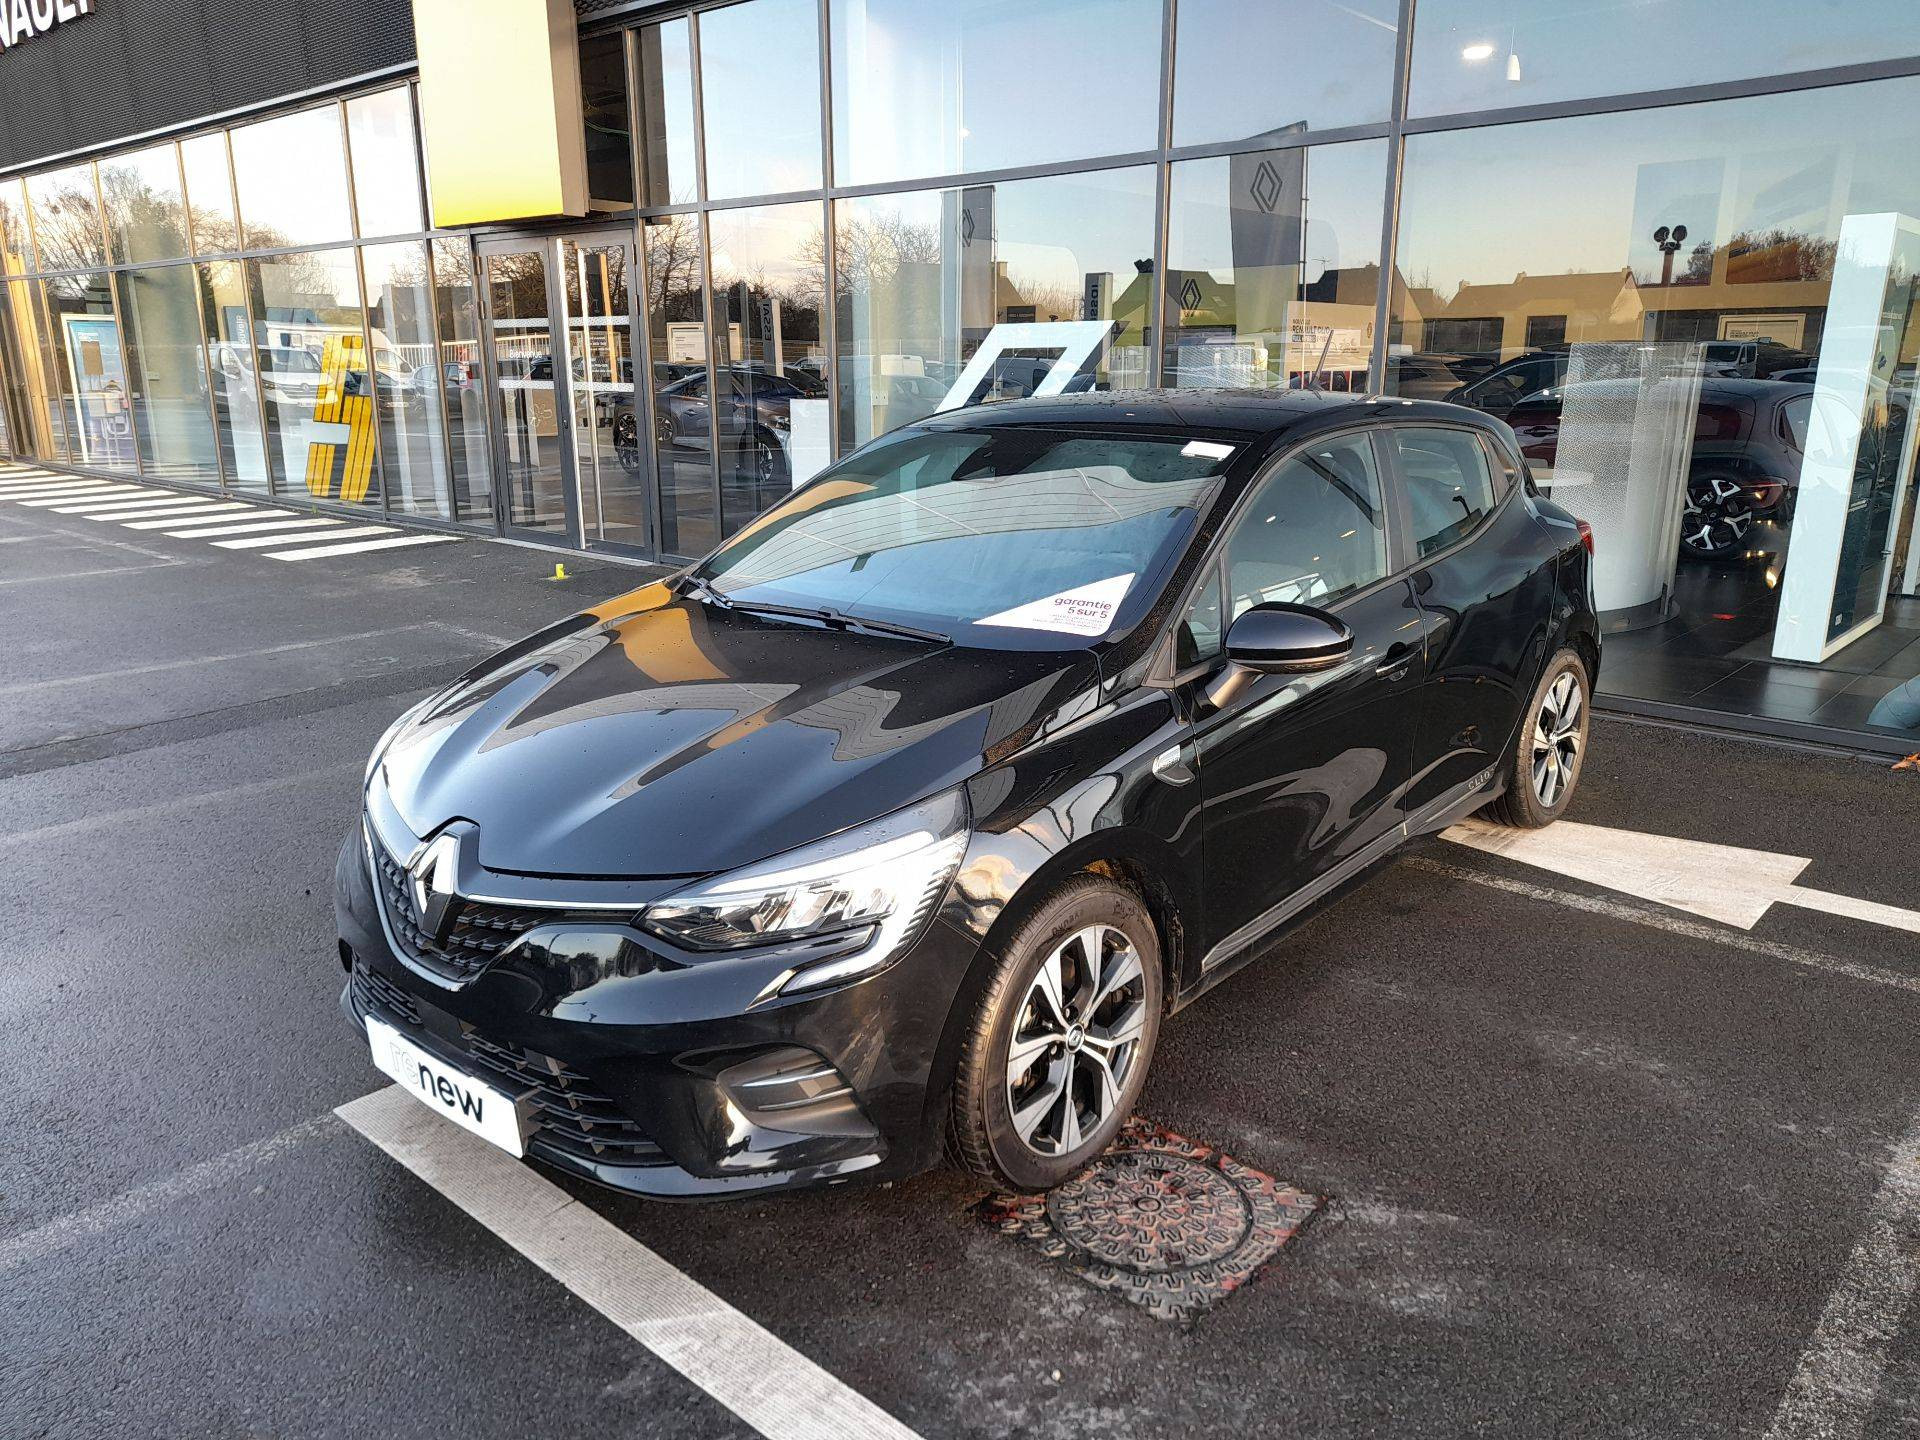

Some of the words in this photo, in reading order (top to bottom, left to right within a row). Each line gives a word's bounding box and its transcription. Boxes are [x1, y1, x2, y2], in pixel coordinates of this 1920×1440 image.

[0, 0, 88, 47] AUL
[1054, 598, 1112, 610] garantie
[1068, 606, 1076, 614] 5
[1077, 608, 1098, 617] sur
[1100, 610, 1108, 619] 5
[1468, 771, 1491, 790] CLIO
